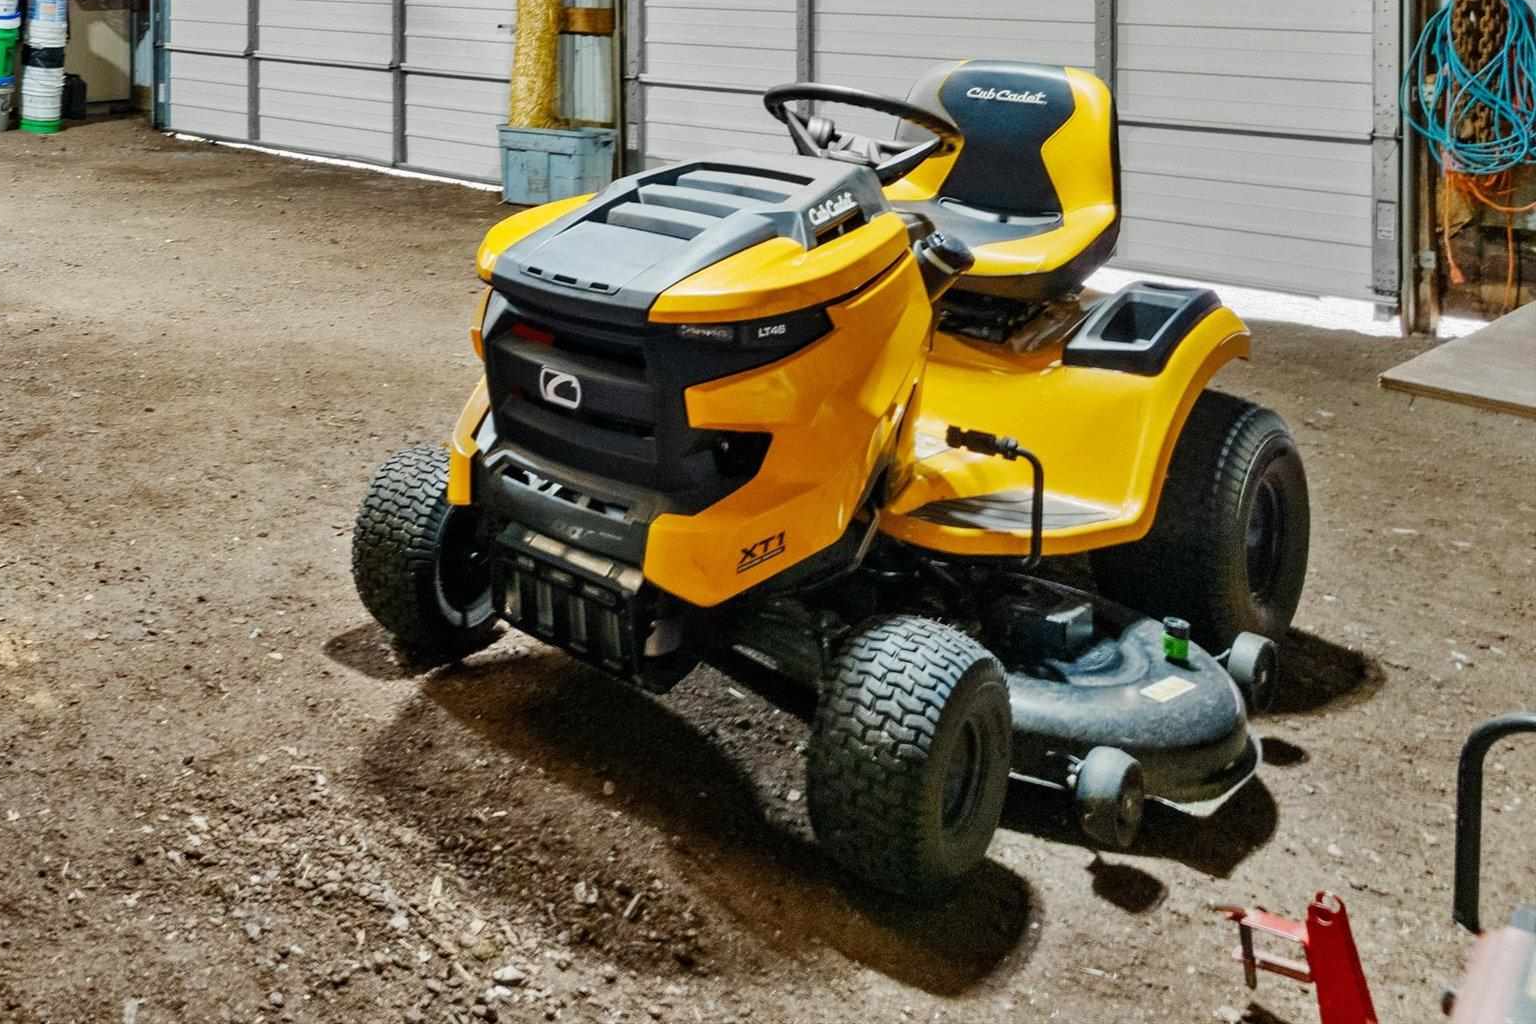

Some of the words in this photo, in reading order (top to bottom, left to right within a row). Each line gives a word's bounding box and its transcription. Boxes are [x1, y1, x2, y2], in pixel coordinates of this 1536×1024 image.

[966, 87, 996, 100] Cub
[996, 89, 1047, 104] Cadet
[739, 531, 785, 564] XT1
